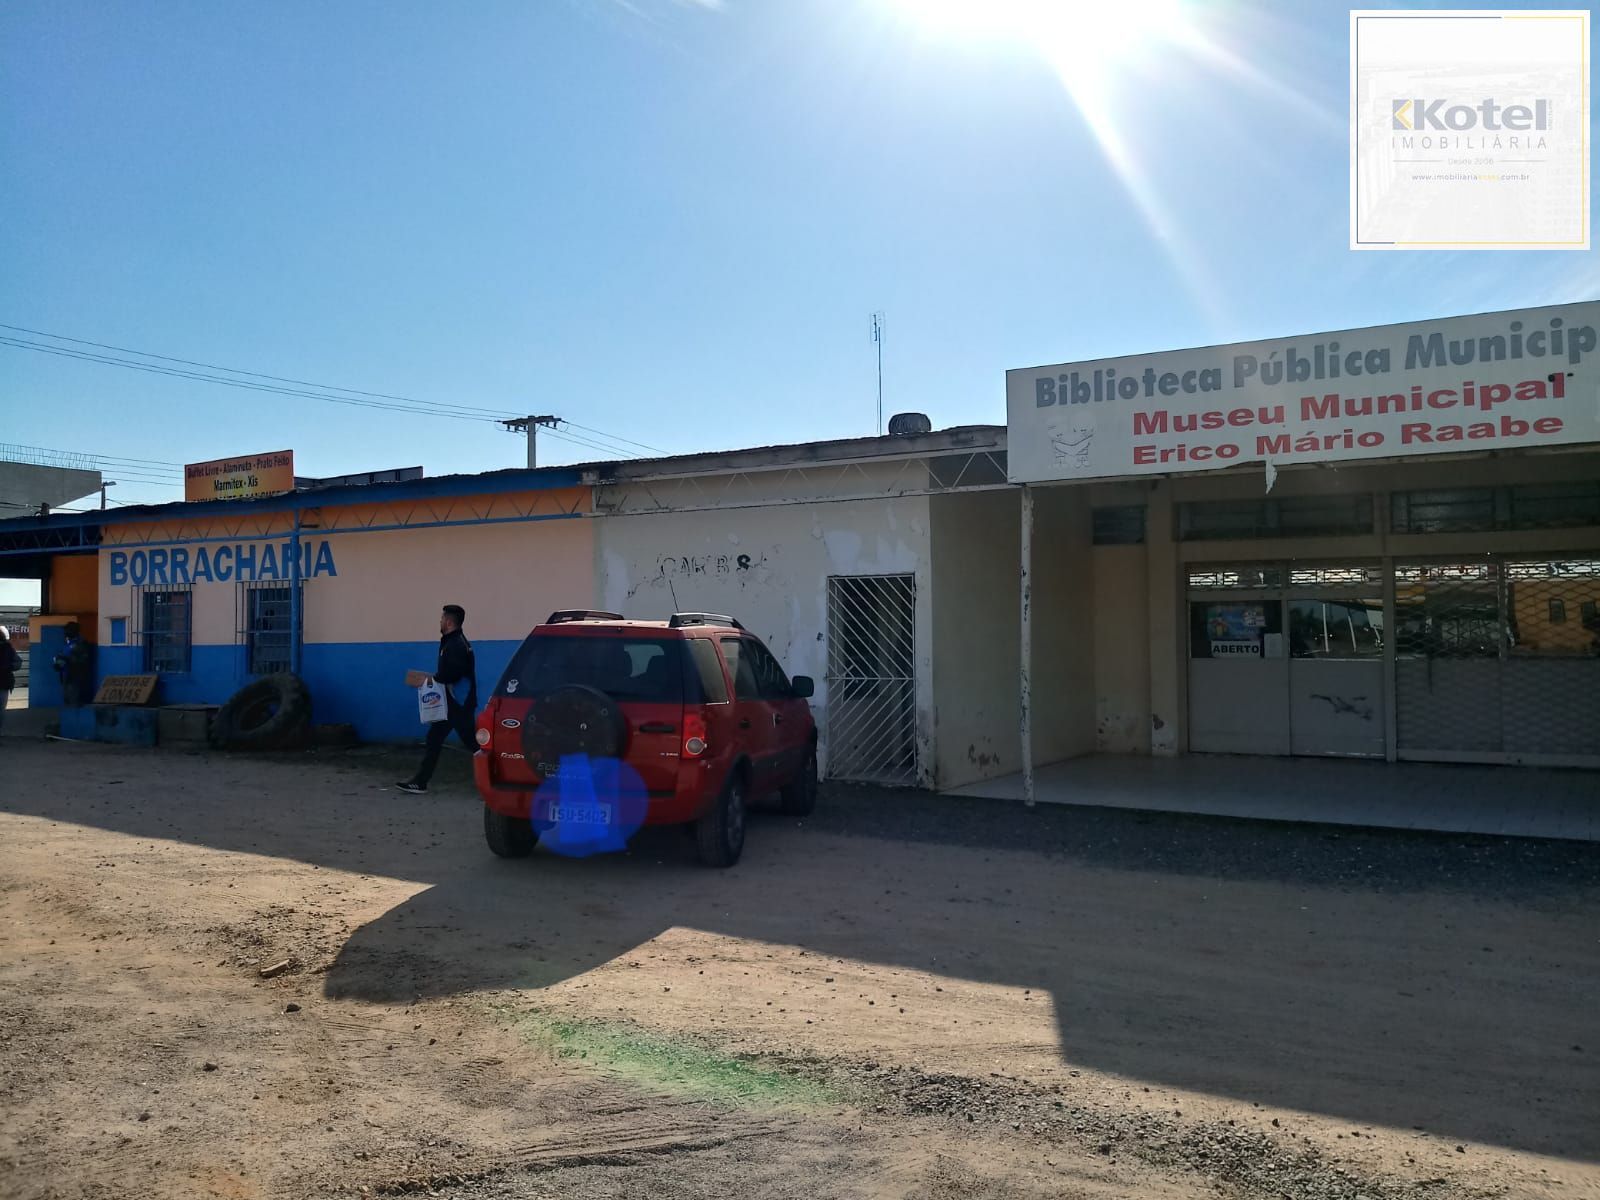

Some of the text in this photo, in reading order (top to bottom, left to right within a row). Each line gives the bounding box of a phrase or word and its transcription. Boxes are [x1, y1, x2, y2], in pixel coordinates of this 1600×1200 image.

[1036, 317, 1600, 409] Biblioteca Pública Municip
[1133, 371, 1566, 436] Museu Municipal
[1133, 414, 1564, 465] Erico Mário Raabe
[214, 475, 259, 491] Marmitex Xis
[110, 541, 338, 586] BORRACHARIA
[1212, 645, 1260, 654] ABERTO
